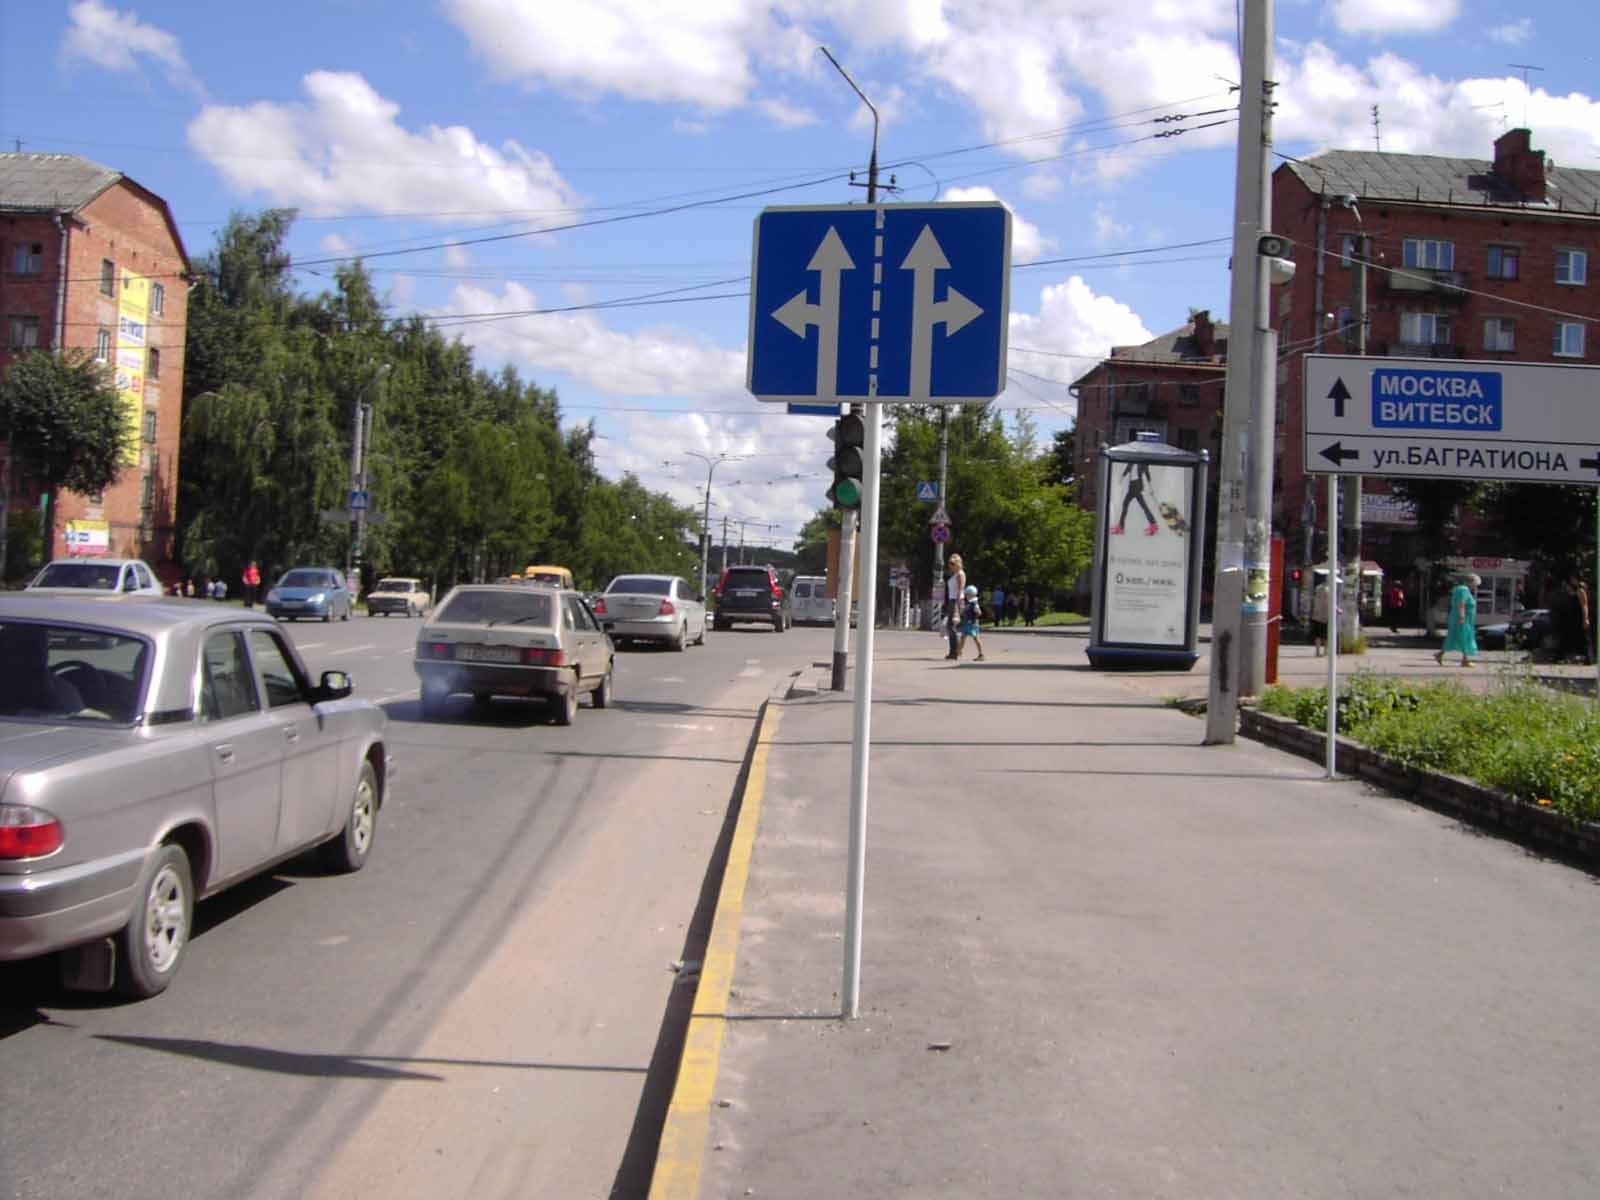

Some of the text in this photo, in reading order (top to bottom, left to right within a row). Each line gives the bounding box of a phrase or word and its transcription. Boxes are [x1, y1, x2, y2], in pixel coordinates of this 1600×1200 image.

[1380, 375, 1484, 398] МОСКВА
[1380, 401, 1494, 425] ВИТЕБСК
[1373, 447, 1569, 471] ул.БАГРАТИОНА
